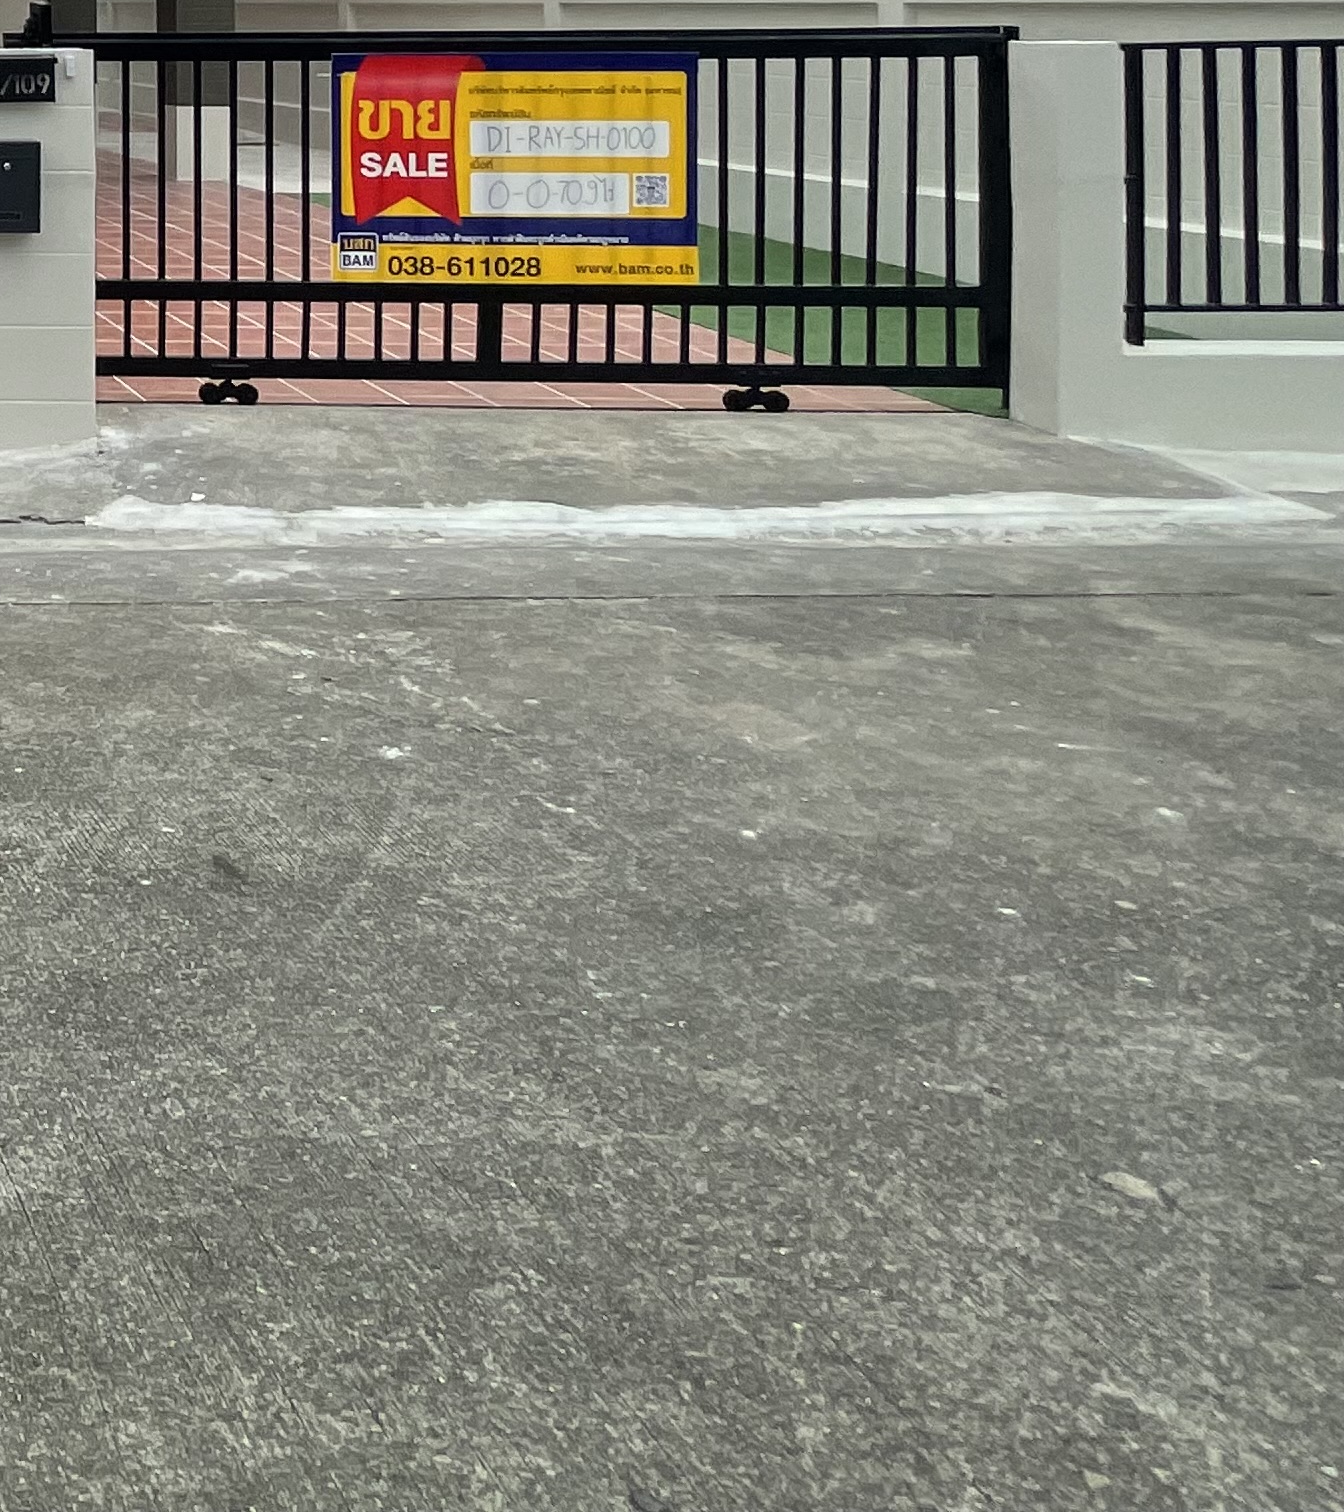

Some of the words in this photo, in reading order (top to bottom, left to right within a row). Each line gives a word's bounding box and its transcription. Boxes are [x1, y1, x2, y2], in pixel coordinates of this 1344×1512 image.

[358, 99, 451, 140] ขาย
[360, 152, 449, 179] SALE
[342, 255, 375, 267] BAM
[388, 256, 541, 277] 038-611028
[575, 263, 695, 276] www.bam.co.th
